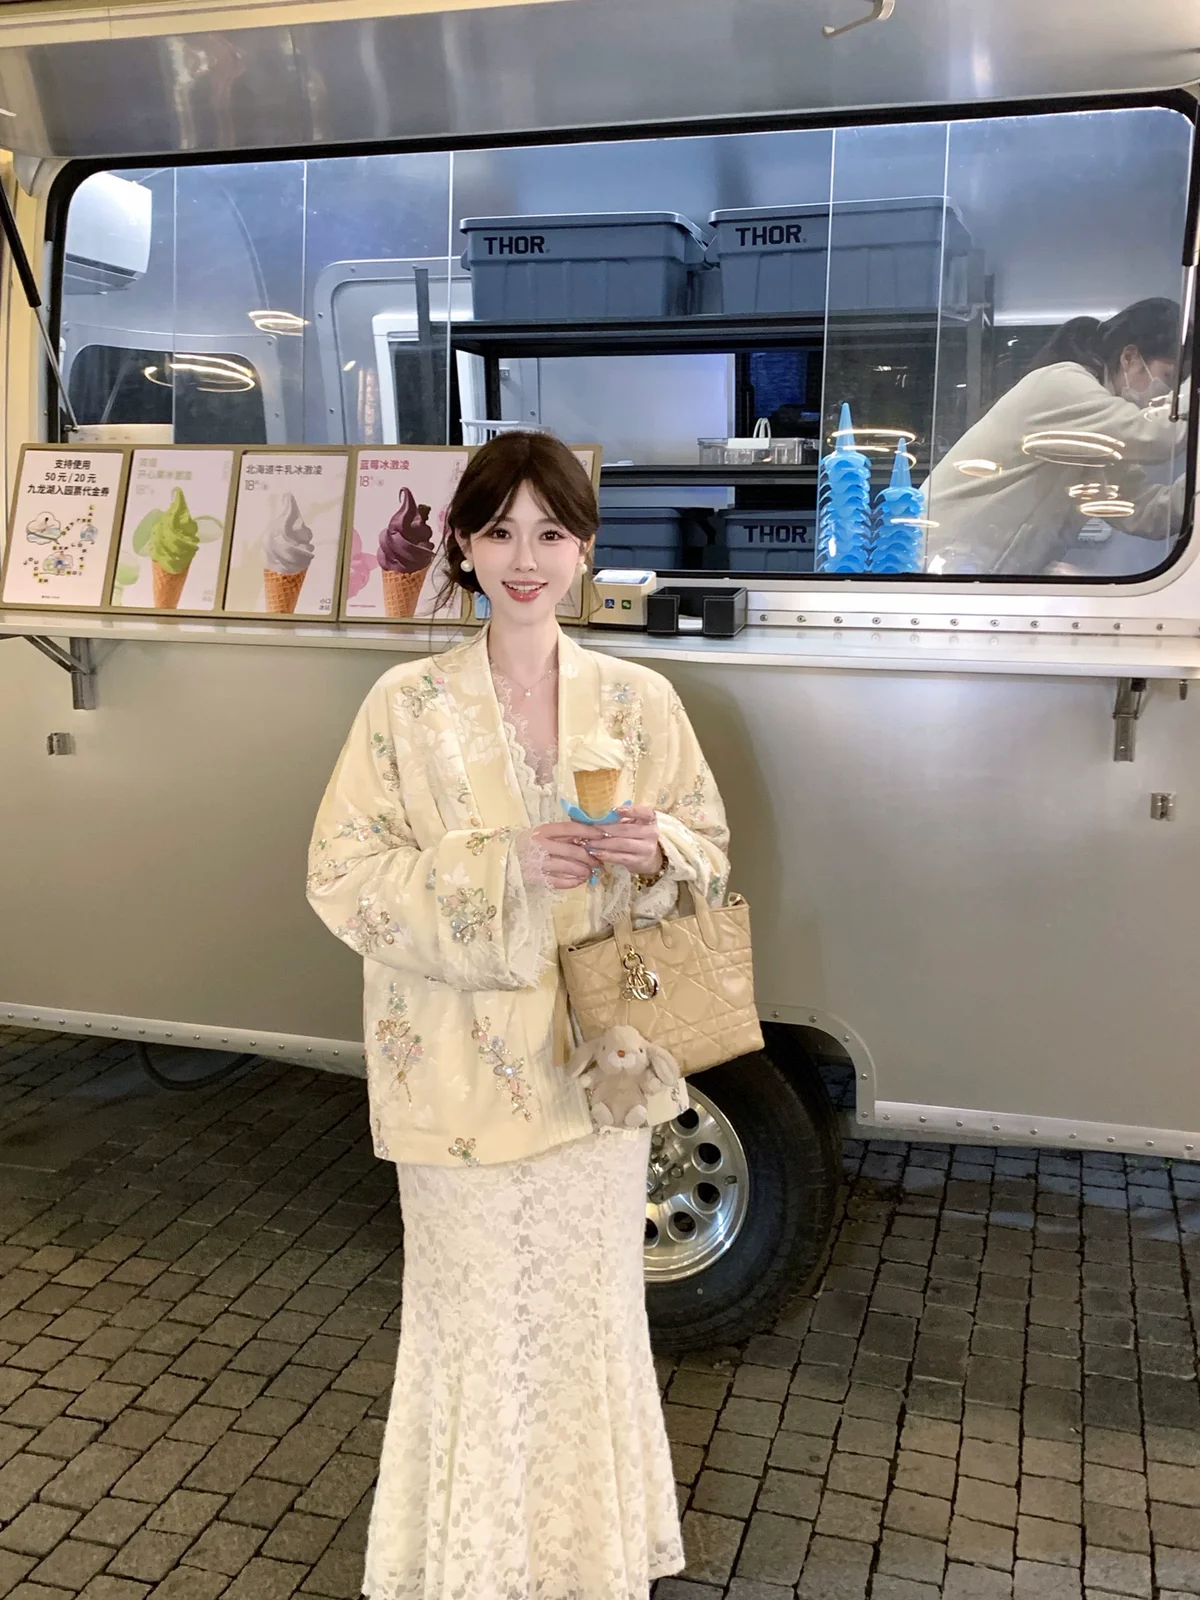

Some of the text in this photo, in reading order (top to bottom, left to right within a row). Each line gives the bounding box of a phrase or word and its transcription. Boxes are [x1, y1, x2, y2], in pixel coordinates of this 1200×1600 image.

[735, 224, 802, 246] THOR
[483, 235, 545, 255] THOR
[54, 459, 91, 470] 支持使用
[359, 459, 410, 470] 蓝莓冰激凌
[743, 525, 807, 543] THOR
